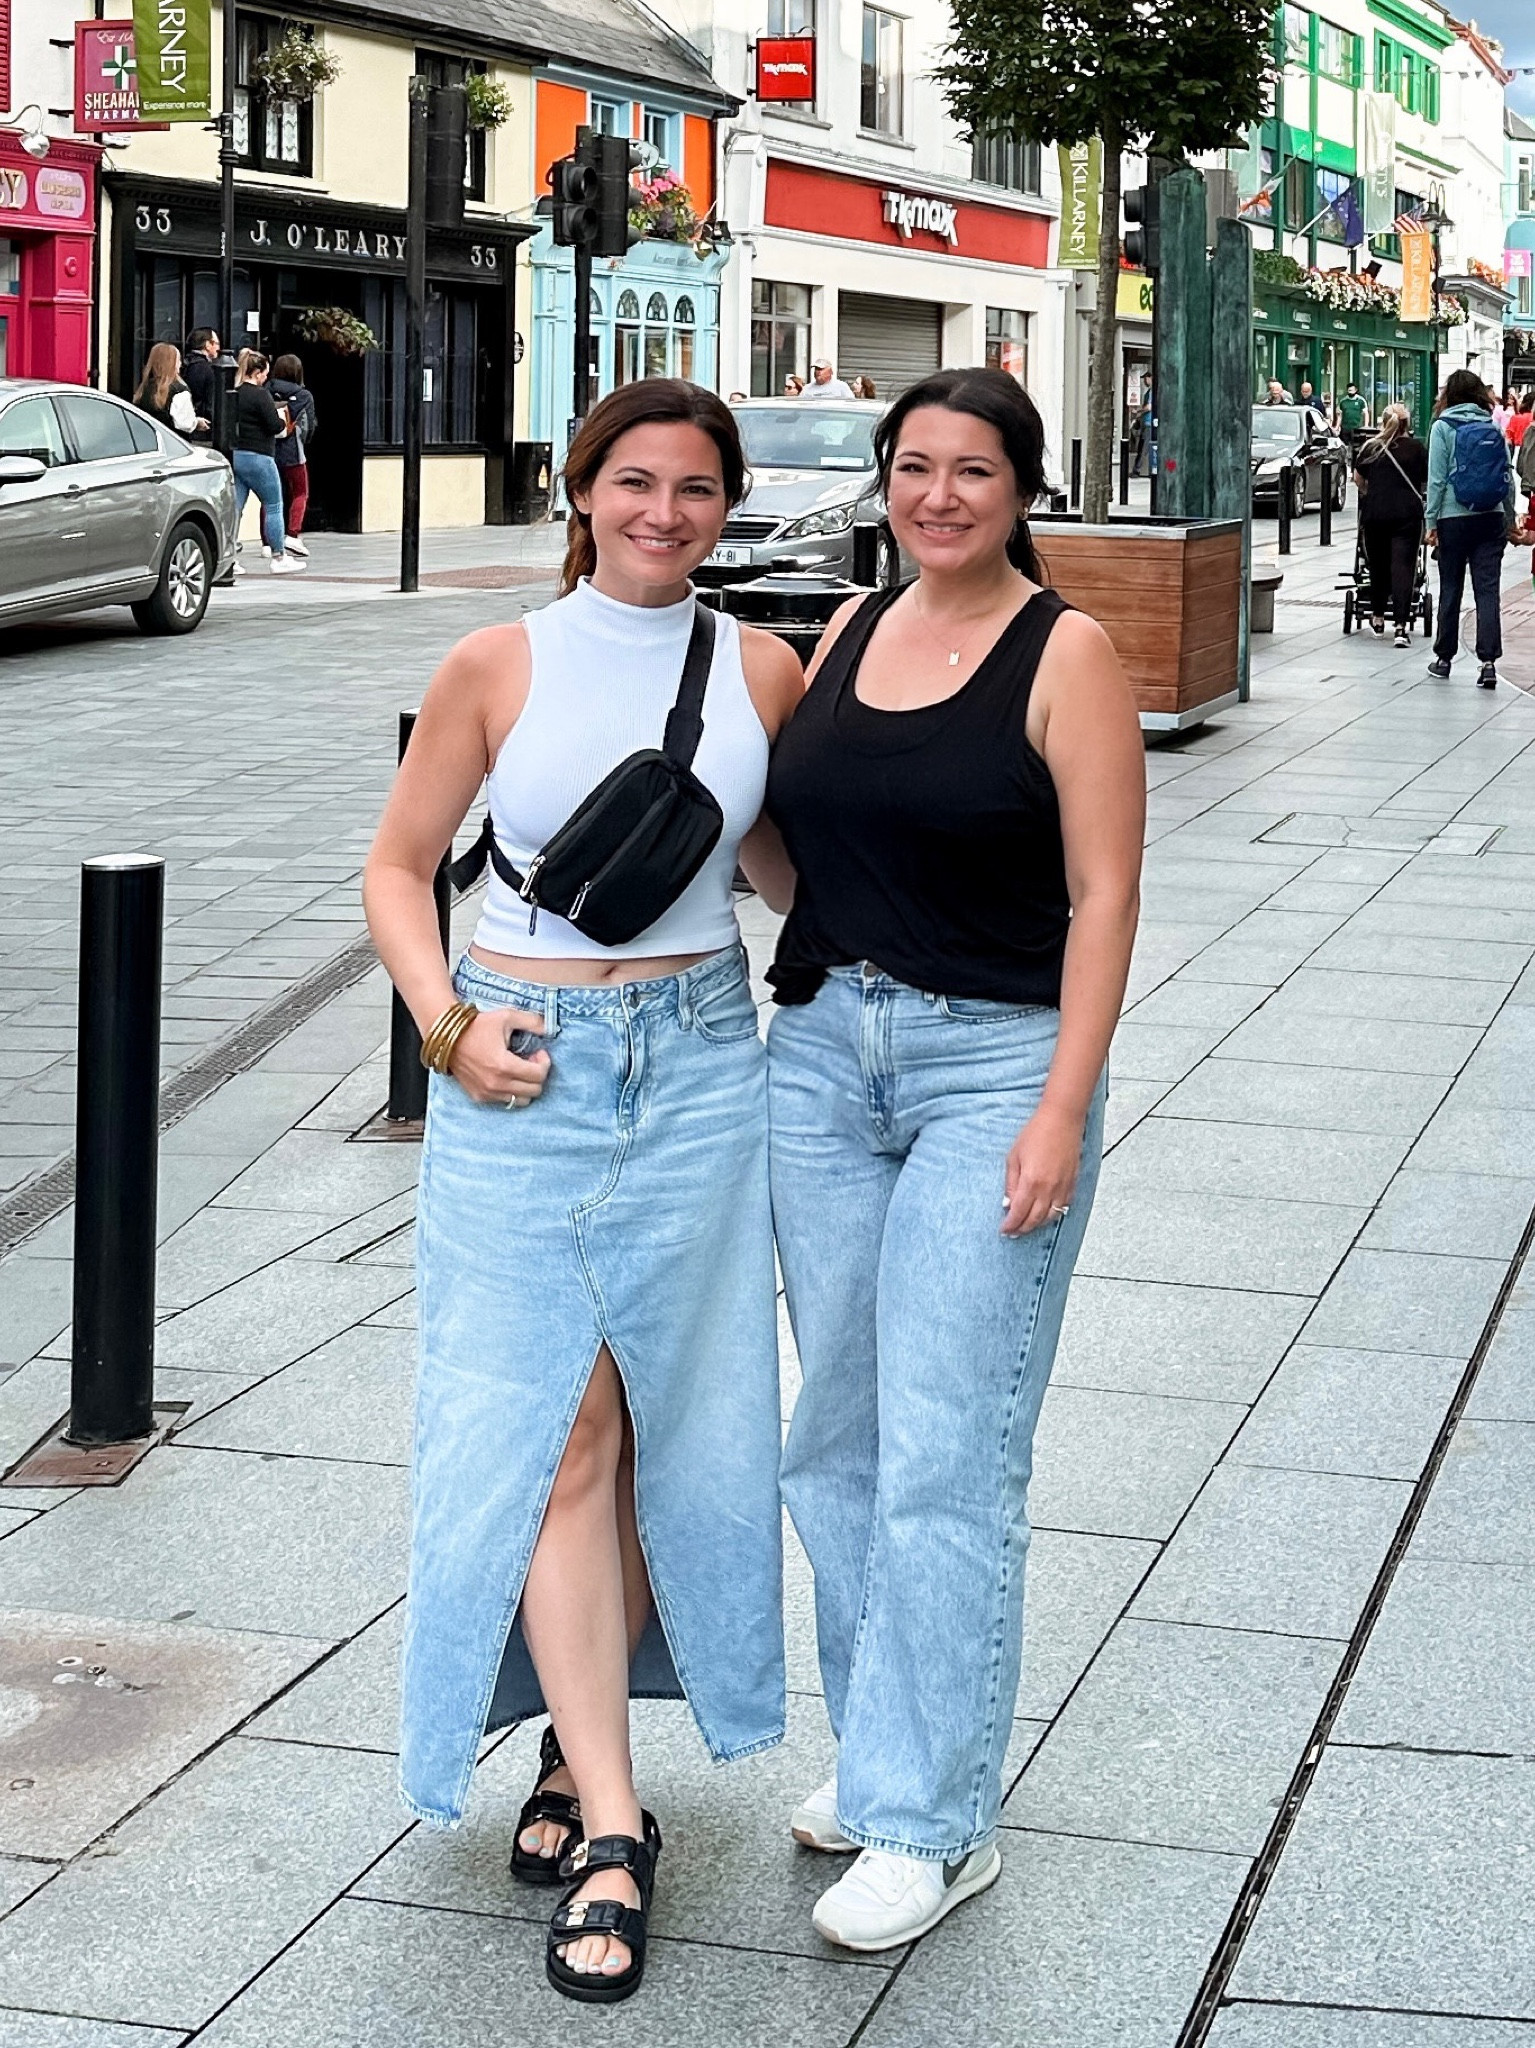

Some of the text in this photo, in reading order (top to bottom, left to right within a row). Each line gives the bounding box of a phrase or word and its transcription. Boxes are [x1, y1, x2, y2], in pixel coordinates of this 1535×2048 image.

[84, 110, 140, 120] PHARMA
[0, 167, 24, 209] Y
[1071, 162, 1088, 256] KILLARNEY
[135, 205, 496, 269] 33 J. O'LEARY 33
